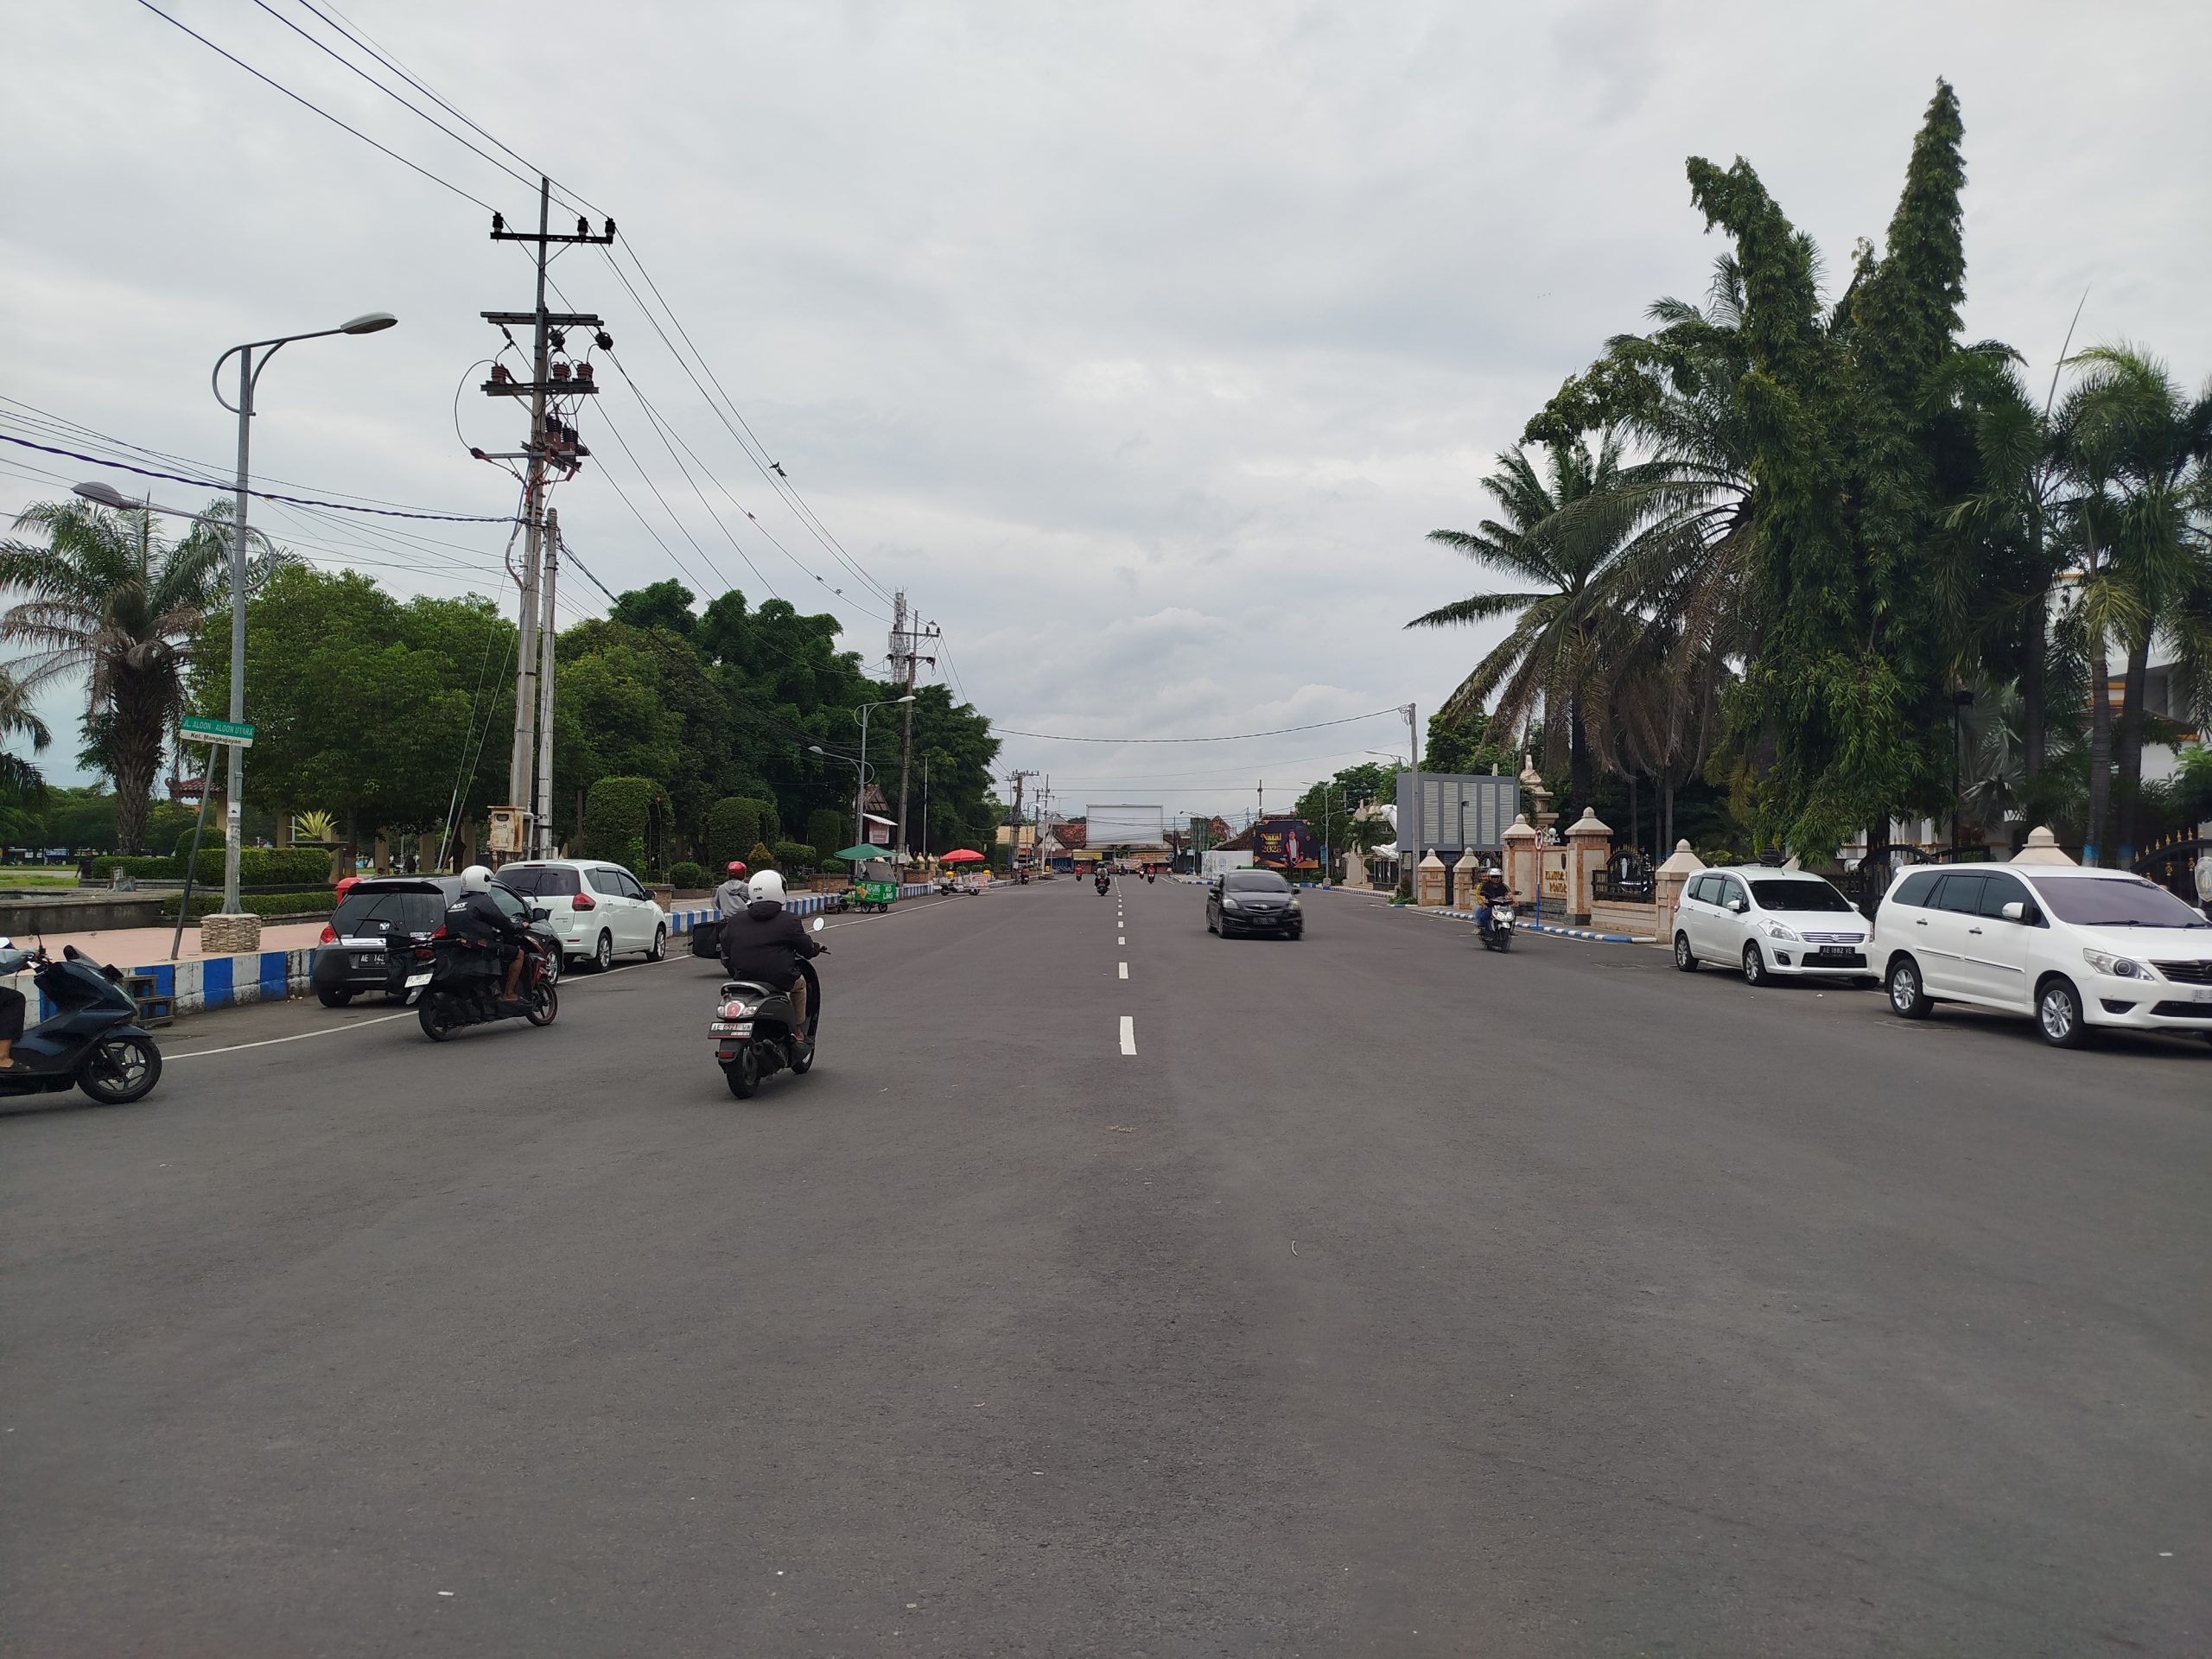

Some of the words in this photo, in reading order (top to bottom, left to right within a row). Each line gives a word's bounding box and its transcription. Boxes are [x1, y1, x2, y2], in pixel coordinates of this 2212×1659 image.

[192, 721, 212, 730] ALOON
[215, 724, 234, 734] ALOON
[234, 728, 253, 736] UTARA
[203, 734, 242, 745] Mangkujayan
[1260, 832, 1282, 842] Natal
[1262, 845, 1282, 854] 2025
